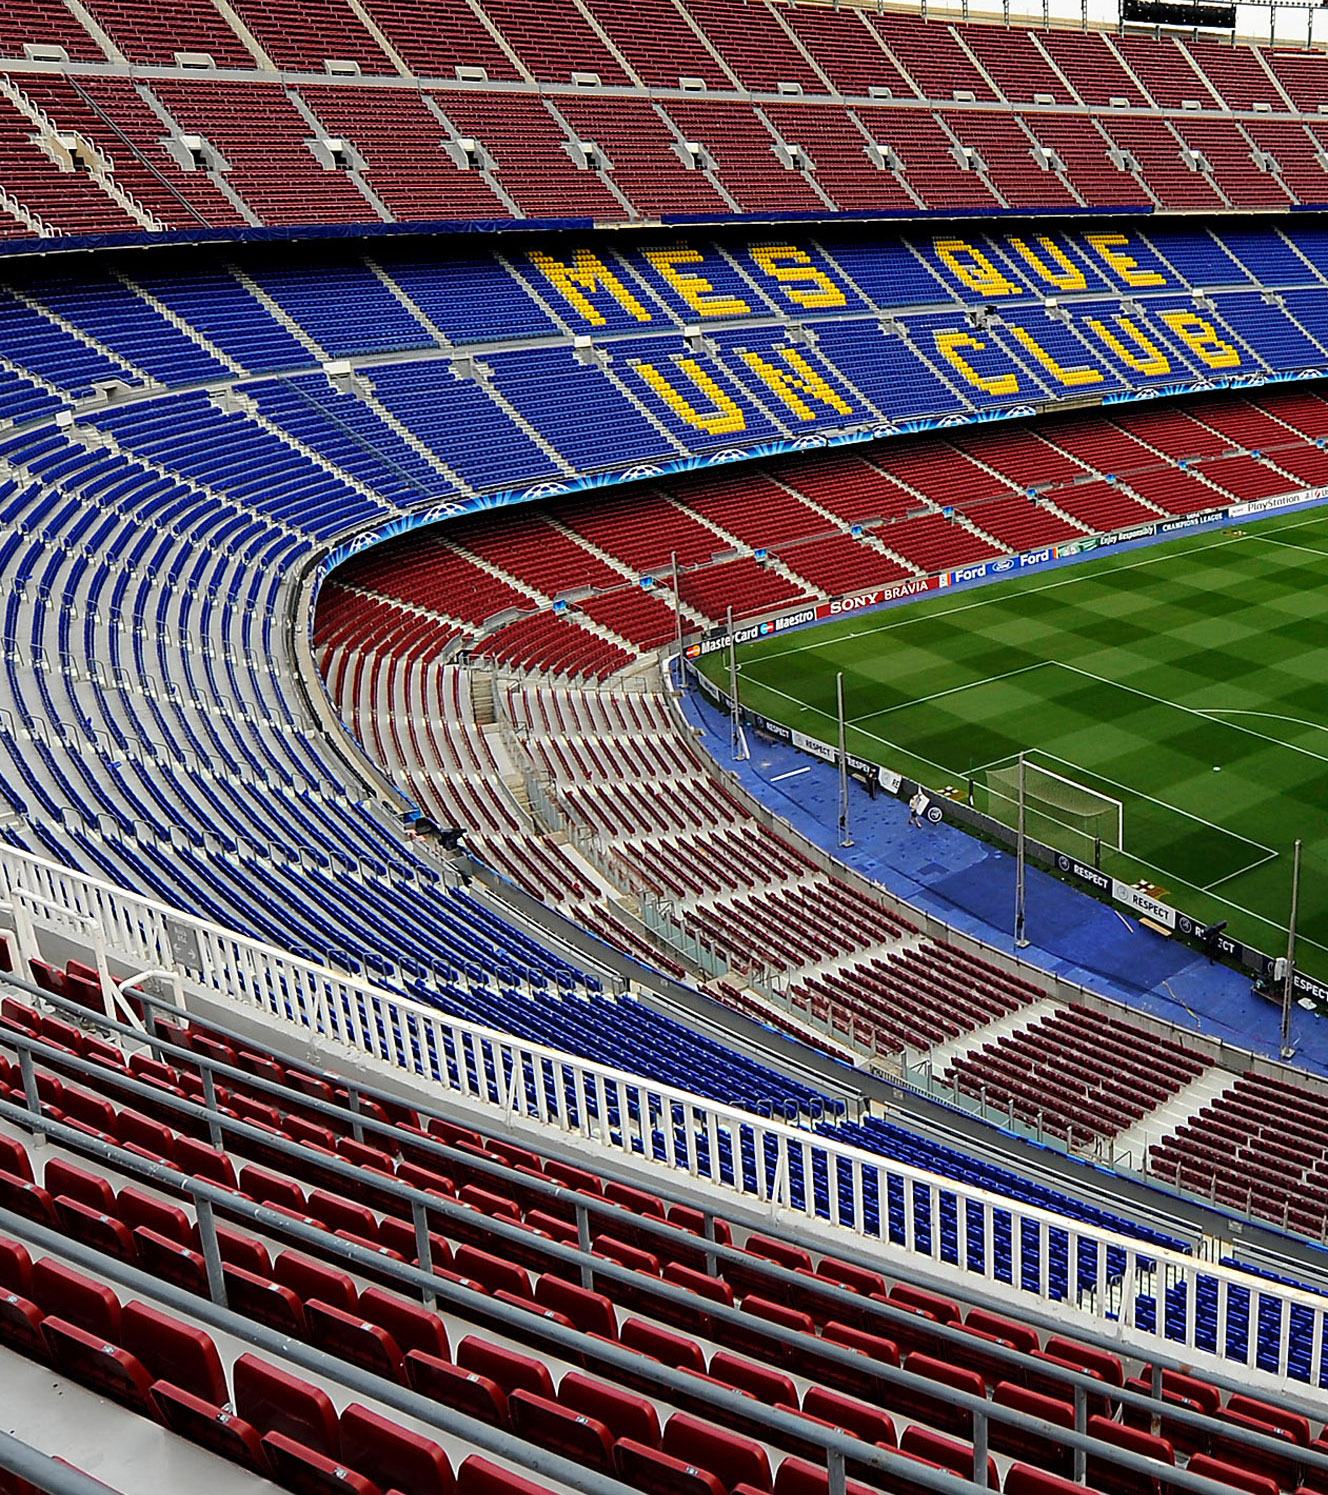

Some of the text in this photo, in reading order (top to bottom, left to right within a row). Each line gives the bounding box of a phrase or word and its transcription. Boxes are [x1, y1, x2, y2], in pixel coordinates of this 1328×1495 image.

[934, 234, 1167, 296] QUE
[633, 311, 1241, 435] UN CLUB
[1248, 495, 1300, 512] PlayStation
[1020, 549, 1049, 567] Ford
[955, 564, 986, 582] Ford
[830, 580, 928, 615] SONY BRAVIA
[775, 610, 814, 630] Maestro
[805, 739, 831, 757] RESPECT
[1074, 864, 1109, 890] RESPECT
[1132, 894, 1169, 920] RESPECT
